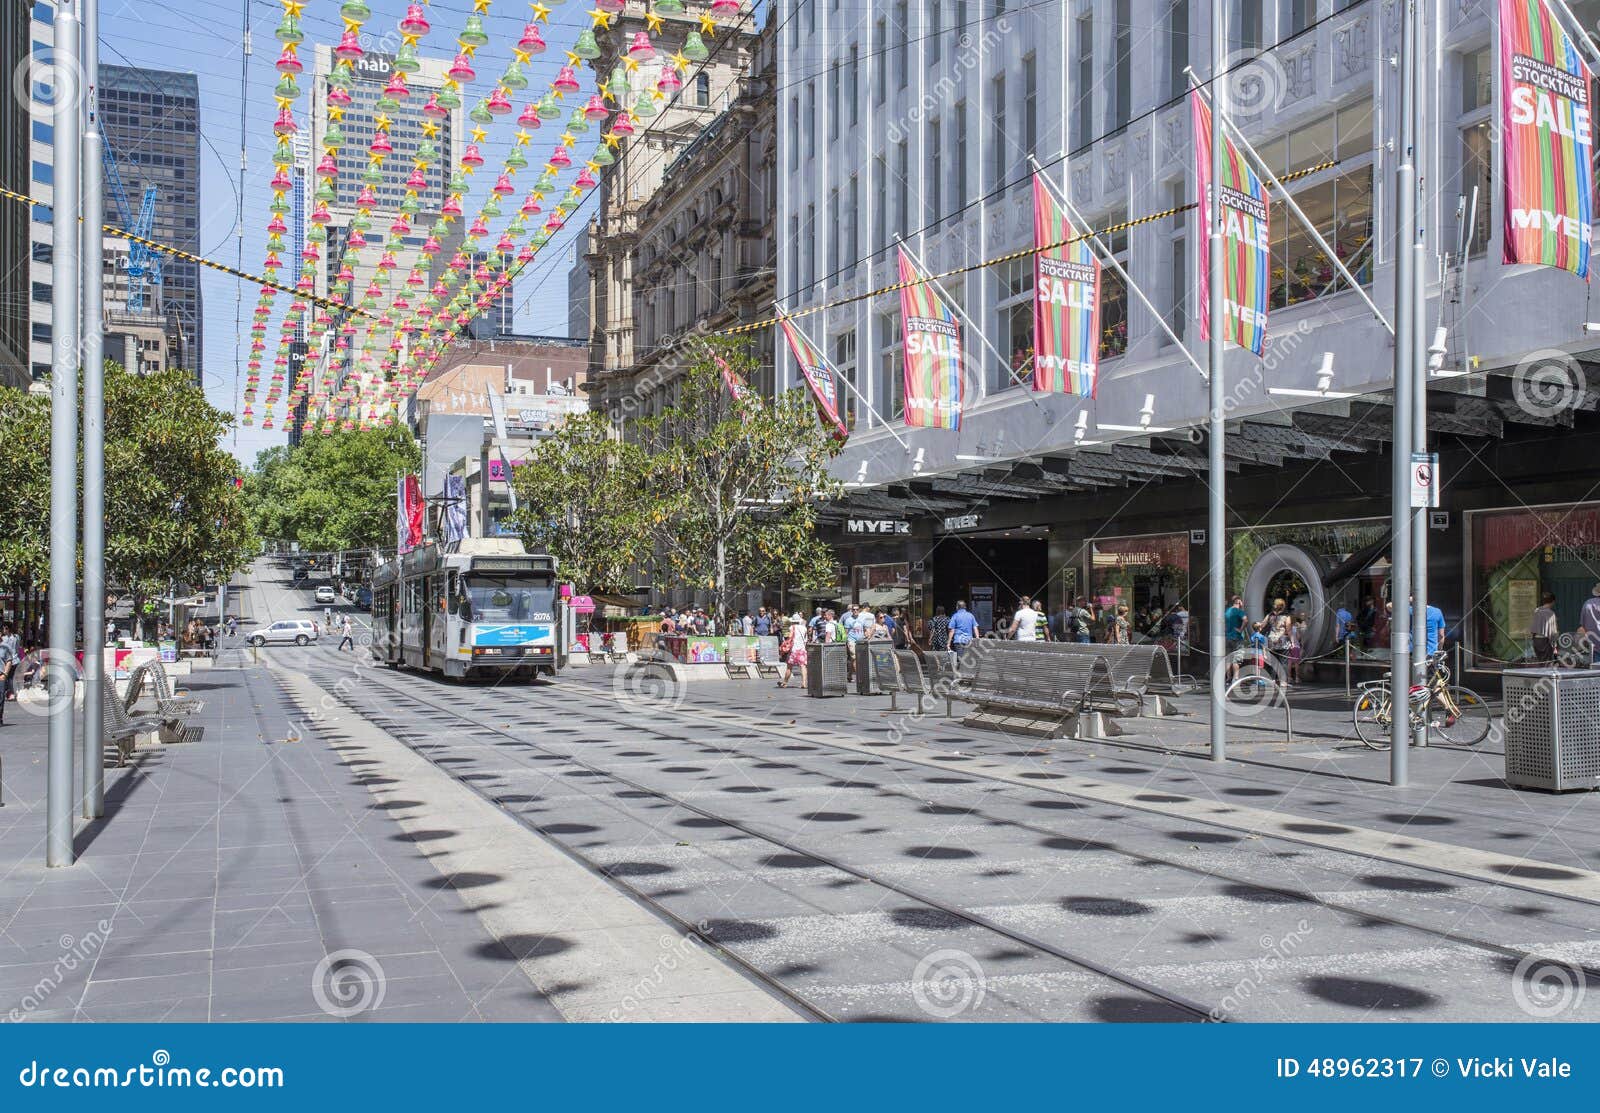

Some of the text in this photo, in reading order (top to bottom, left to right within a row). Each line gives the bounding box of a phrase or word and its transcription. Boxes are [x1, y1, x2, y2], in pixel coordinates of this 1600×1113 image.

[358, 58, 390, 73] nab
[1513, 56, 1585, 87] AUSTRALIA'S BIGGEST
[1513, 65, 1587, 103] STOCKTAKE
[1511, 86, 1592, 146] SALE
[1208, 190, 1267, 220] SOCKTAKE
[1512, 208, 1592, 248] MYER
[1040, 263, 1095, 283] STOCKTAKE
[1038, 277, 1095, 311] SALE
[907, 322, 957, 337] STOCKTAKE
[907, 333, 960, 359] SALE
[1037, 354, 1096, 377] MYER
[908, 397, 962, 413] MYER
[848, 519, 912, 534] MYER
[944, 514, 979, 530] MYER
[533, 612, 551, 621] 2076
